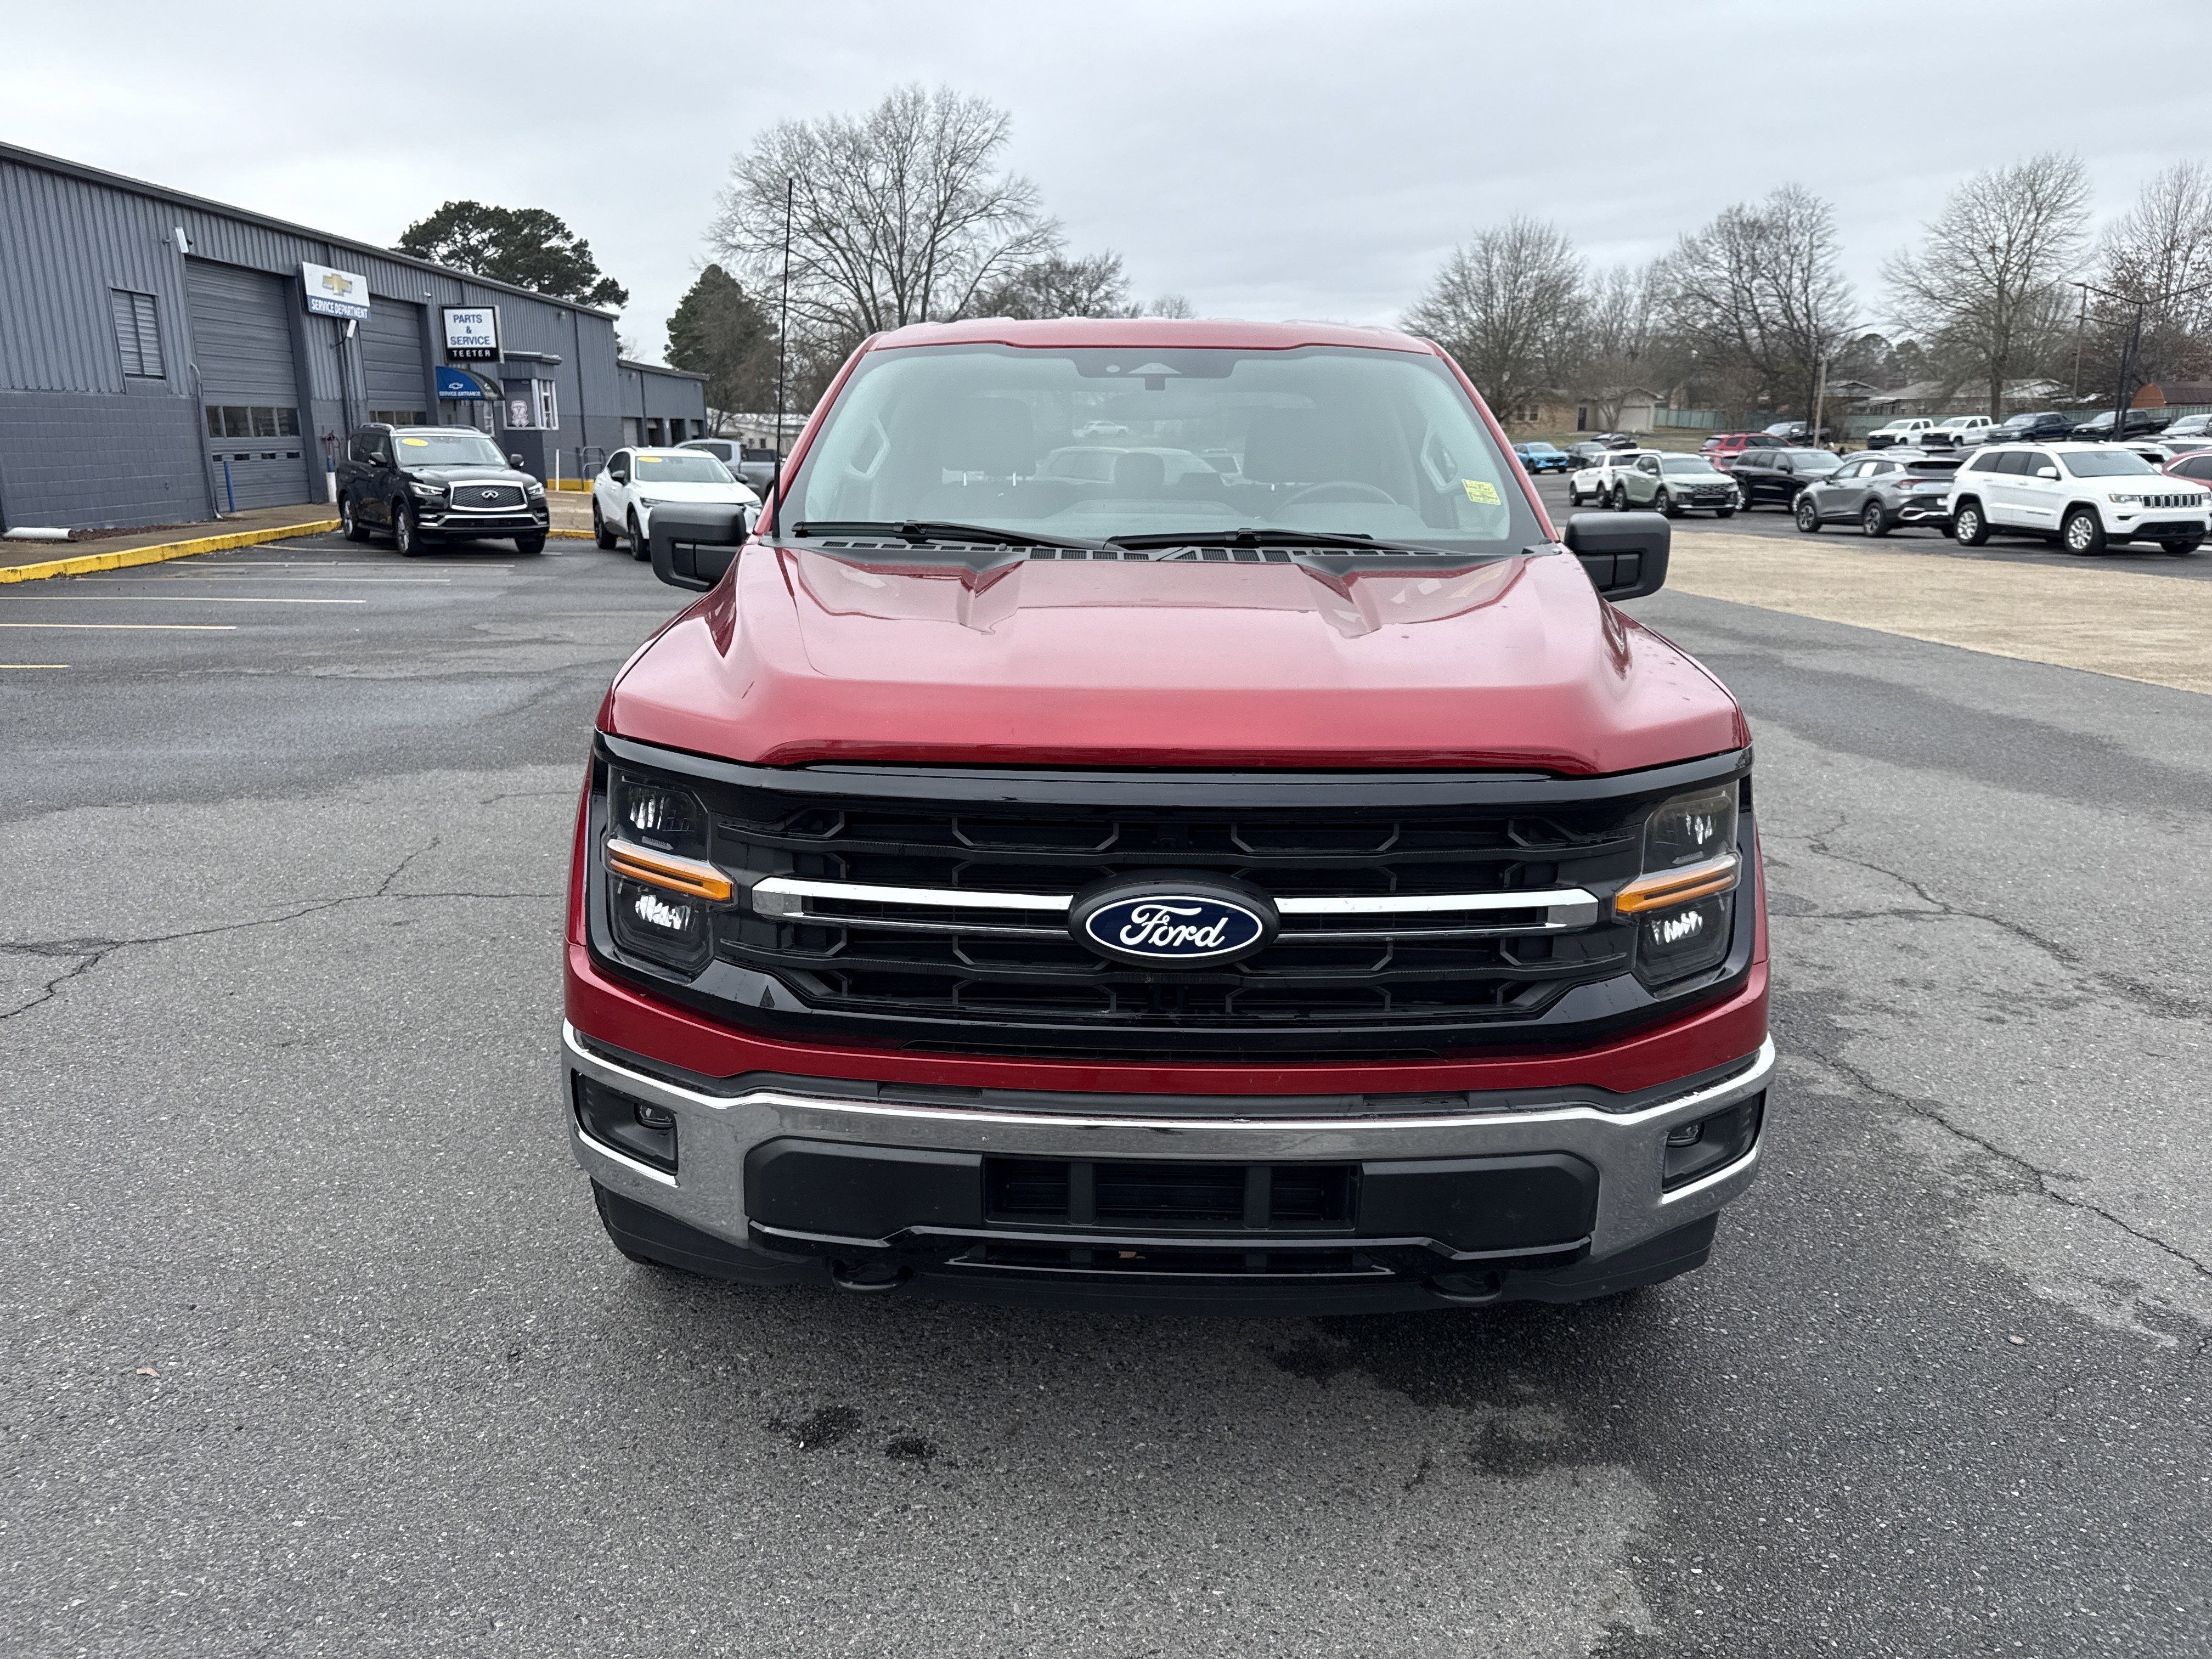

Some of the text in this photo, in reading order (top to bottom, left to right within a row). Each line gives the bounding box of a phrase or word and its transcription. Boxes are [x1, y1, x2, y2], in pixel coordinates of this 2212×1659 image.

[312, 298, 368, 319] SERVICE DEPARTMENT
[453, 314, 482, 323] PARTS
[466, 326, 472, 334] &
[450, 336, 490, 345] SERVICE
[1120, 905, 1228, 947] Ford
